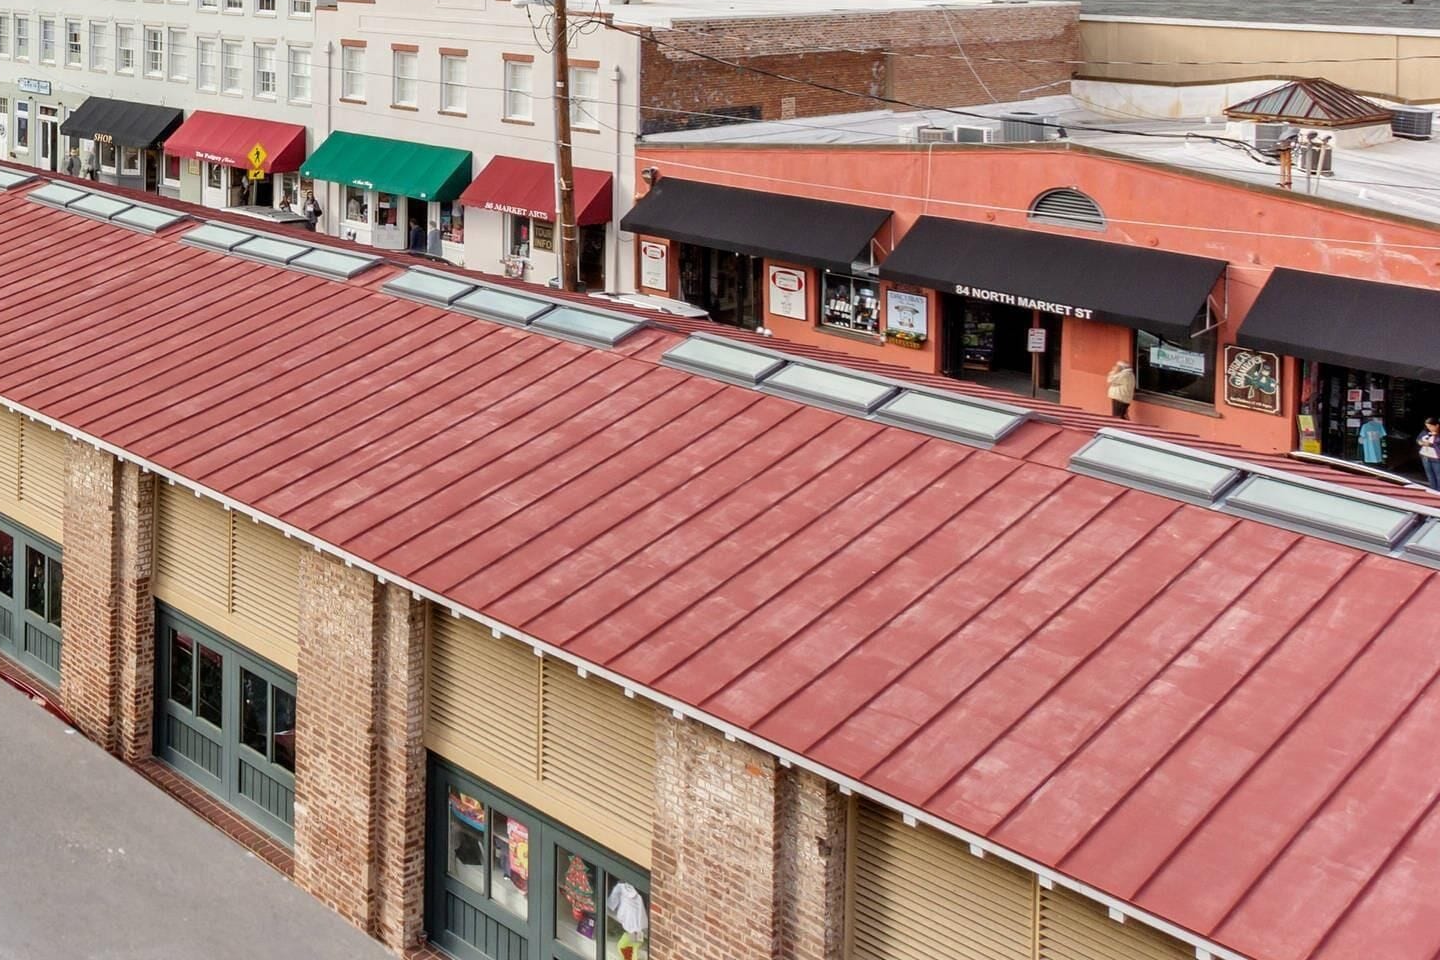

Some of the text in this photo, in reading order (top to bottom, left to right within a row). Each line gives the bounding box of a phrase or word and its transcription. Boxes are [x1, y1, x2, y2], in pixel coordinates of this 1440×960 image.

[495, 203, 527, 216] MARKET
[528, 210, 548, 219] ARTS
[534, 239, 553, 249] INFO
[955, 284, 1093, 319] 84 NORTH MARKET ST
